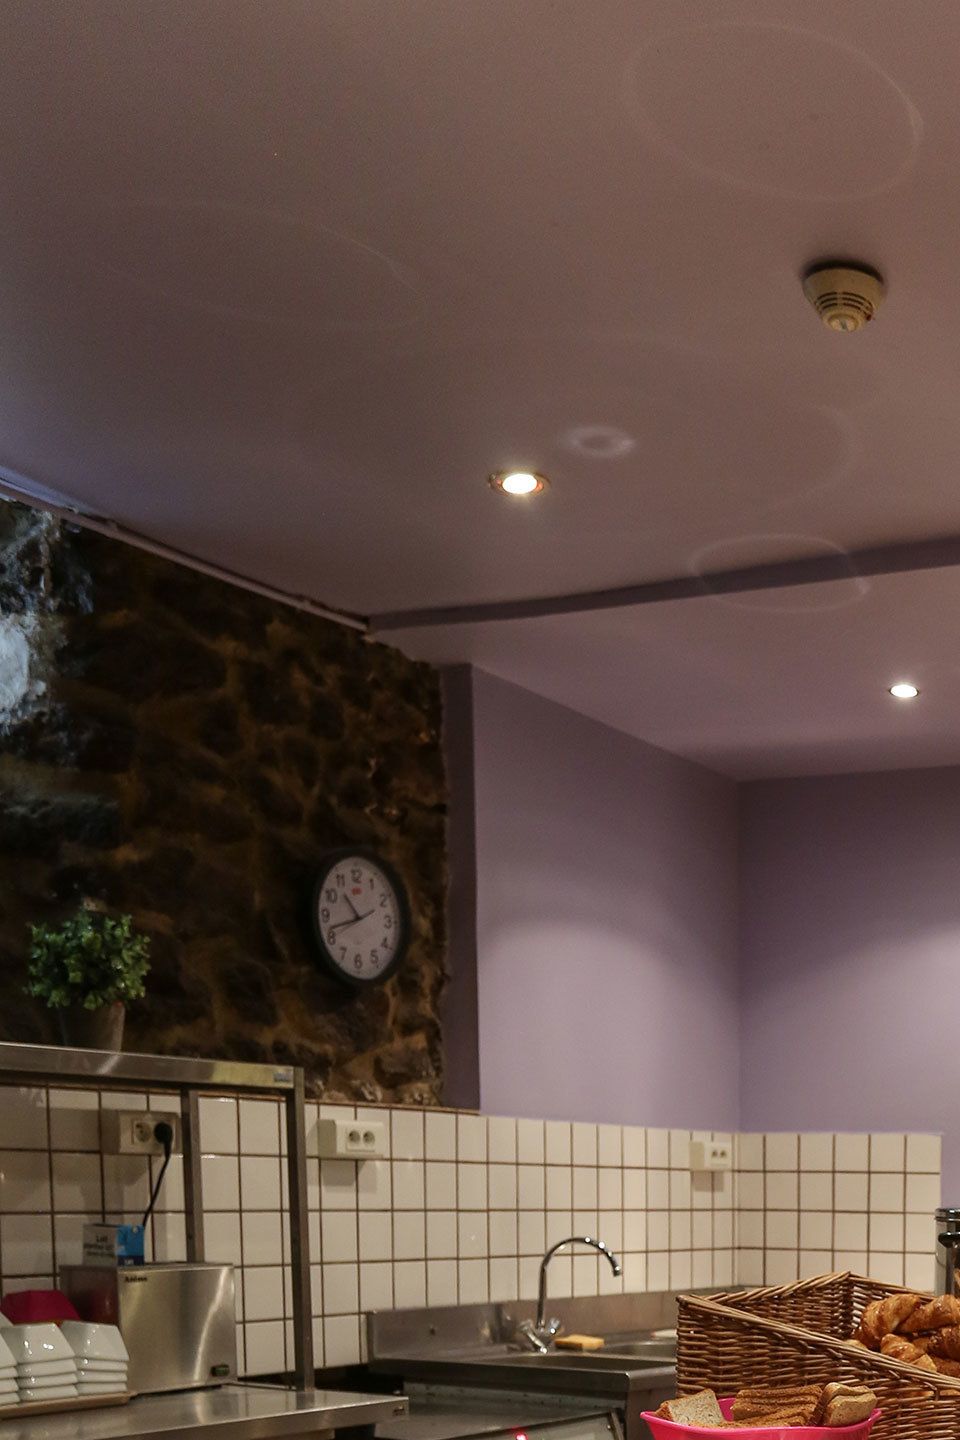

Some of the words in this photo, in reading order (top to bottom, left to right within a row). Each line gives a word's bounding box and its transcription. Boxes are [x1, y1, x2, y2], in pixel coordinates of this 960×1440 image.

[336, 873, 345, 888] 11
[351, 869, 362, 884] 12
[369, 878, 375, 890] 1
[325, 888, 338, 904] 10
[380, 893, 388, 908] 2
[321, 907, 330, 923] 9
[384, 914, 392, 930] 3
[327, 929, 336, 946] 8
[380, 937, 390, 950] 4
[340, 946, 347, 961] 7
[354, 953, 363, 969] 6
[370, 949, 378, 965] 5
